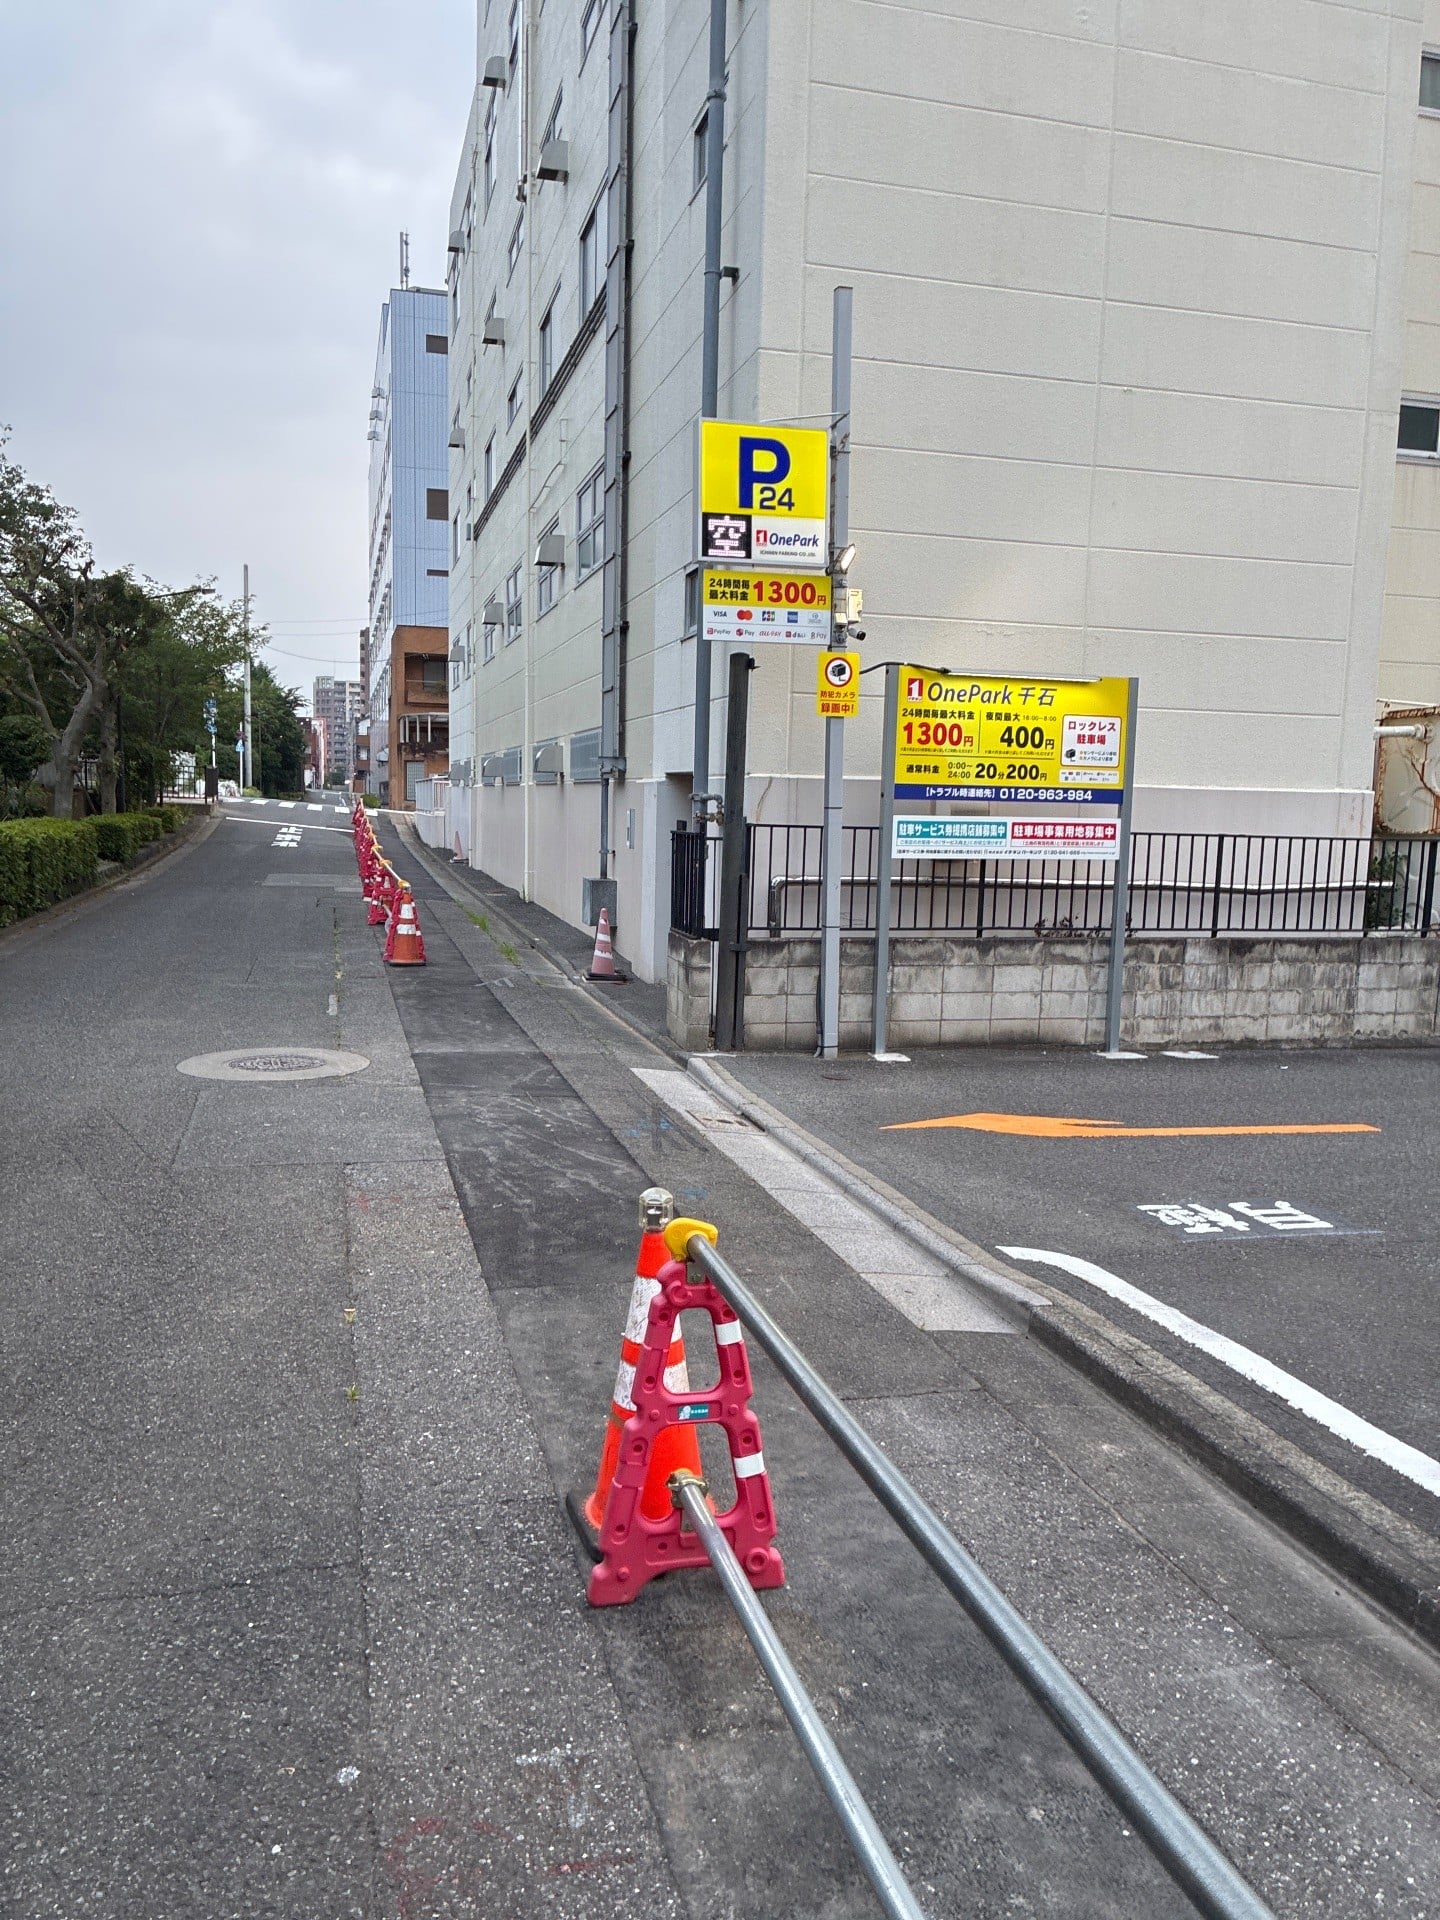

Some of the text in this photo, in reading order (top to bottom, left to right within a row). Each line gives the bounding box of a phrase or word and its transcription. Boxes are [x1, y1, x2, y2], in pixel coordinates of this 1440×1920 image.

[739, 436, 790, 509] P
[759, 486, 795, 511] 24
[708, 516, 746, 557] 空
[769, 532, 819, 547] OnePark
[709, 578, 750, 590] 24時間毎
[709, 590, 749, 601] 最大料金
[753, 580, 827, 605] 1300円
[820, 690, 856, 698] 防犯カメラ
[927, 681, 1013, 705] OnePark
[1018, 687, 1057, 706] 千石
[902, 708, 975, 720] 24時間毎最大料金
[986, 711, 1020, 721] 夜間最大
[1068, 720, 1116, 731] ロックレス
[903, 722, 974, 748] 1300円
[1000, 726, 1055, 750] 400円
[1076, 733, 1106, 745] 駐車場
[906, 764, 940, 774] 通常料金
[947, 770, 971, 779] 24:00
[1000, 788, 1093, 801] 0120-963-984
[1012, 824, 1115, 838] 駐車場事業用地募集中
